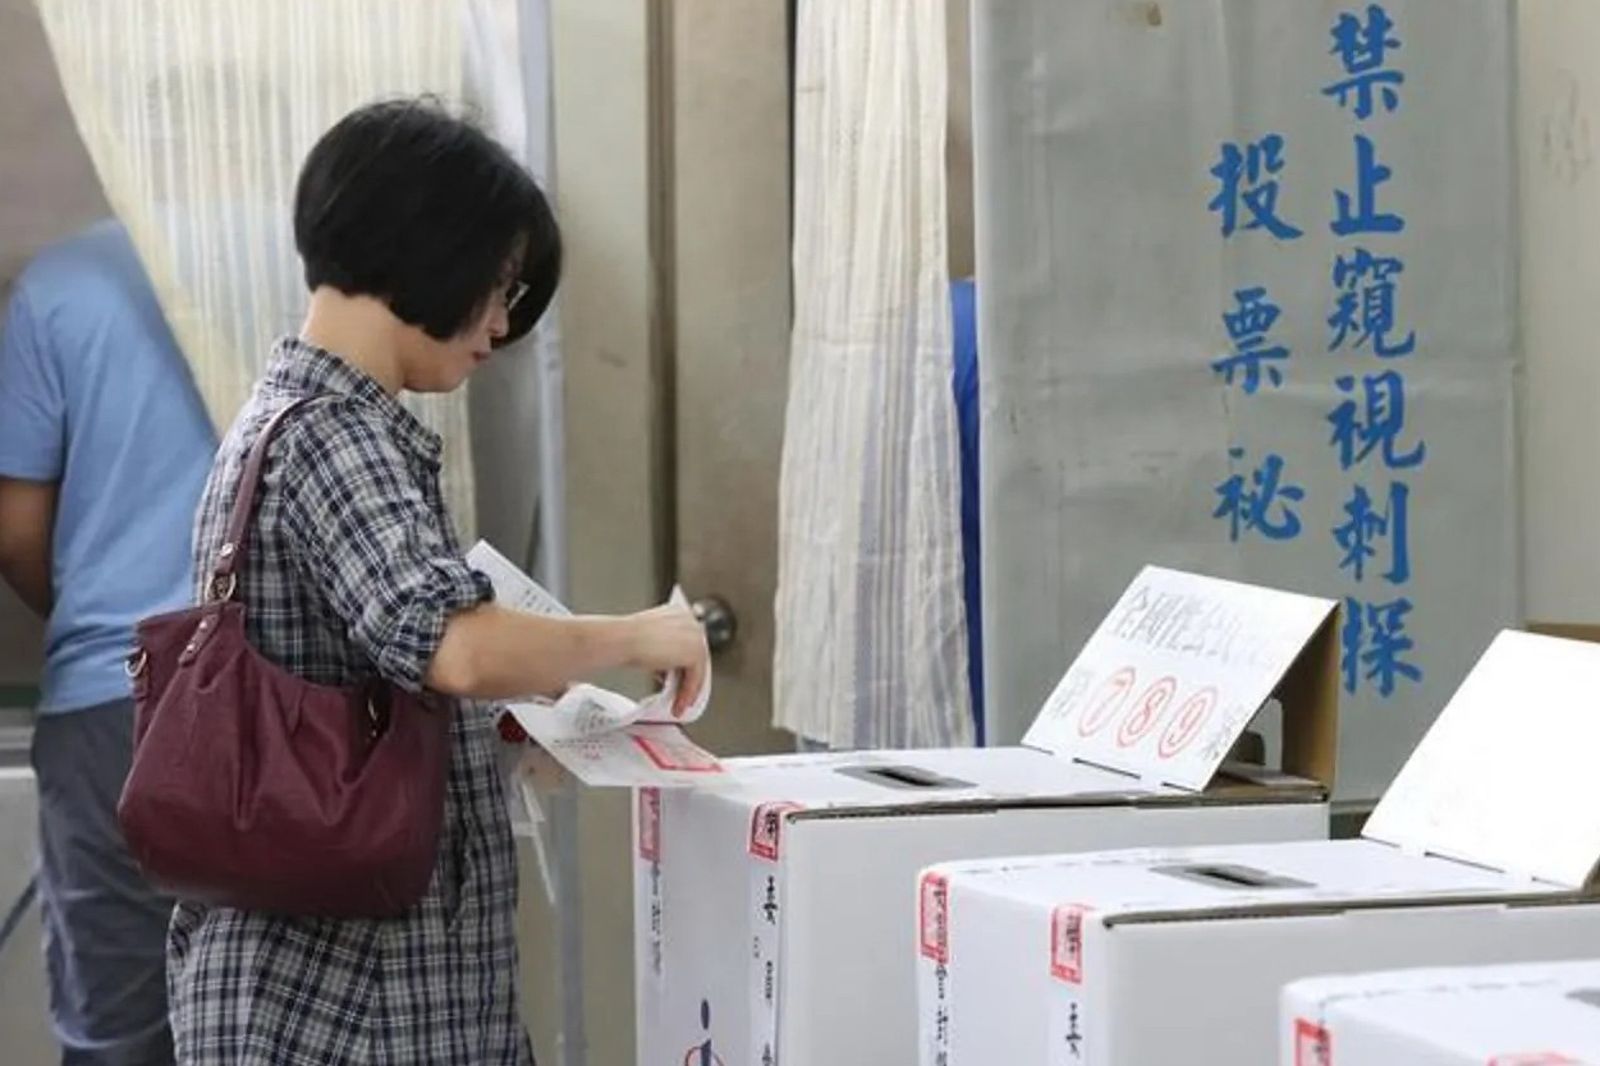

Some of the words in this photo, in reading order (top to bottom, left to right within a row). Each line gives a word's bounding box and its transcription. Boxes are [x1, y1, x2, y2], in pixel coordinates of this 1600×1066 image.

[1322, 4, 1425, 697] 禁止窺視刺探
